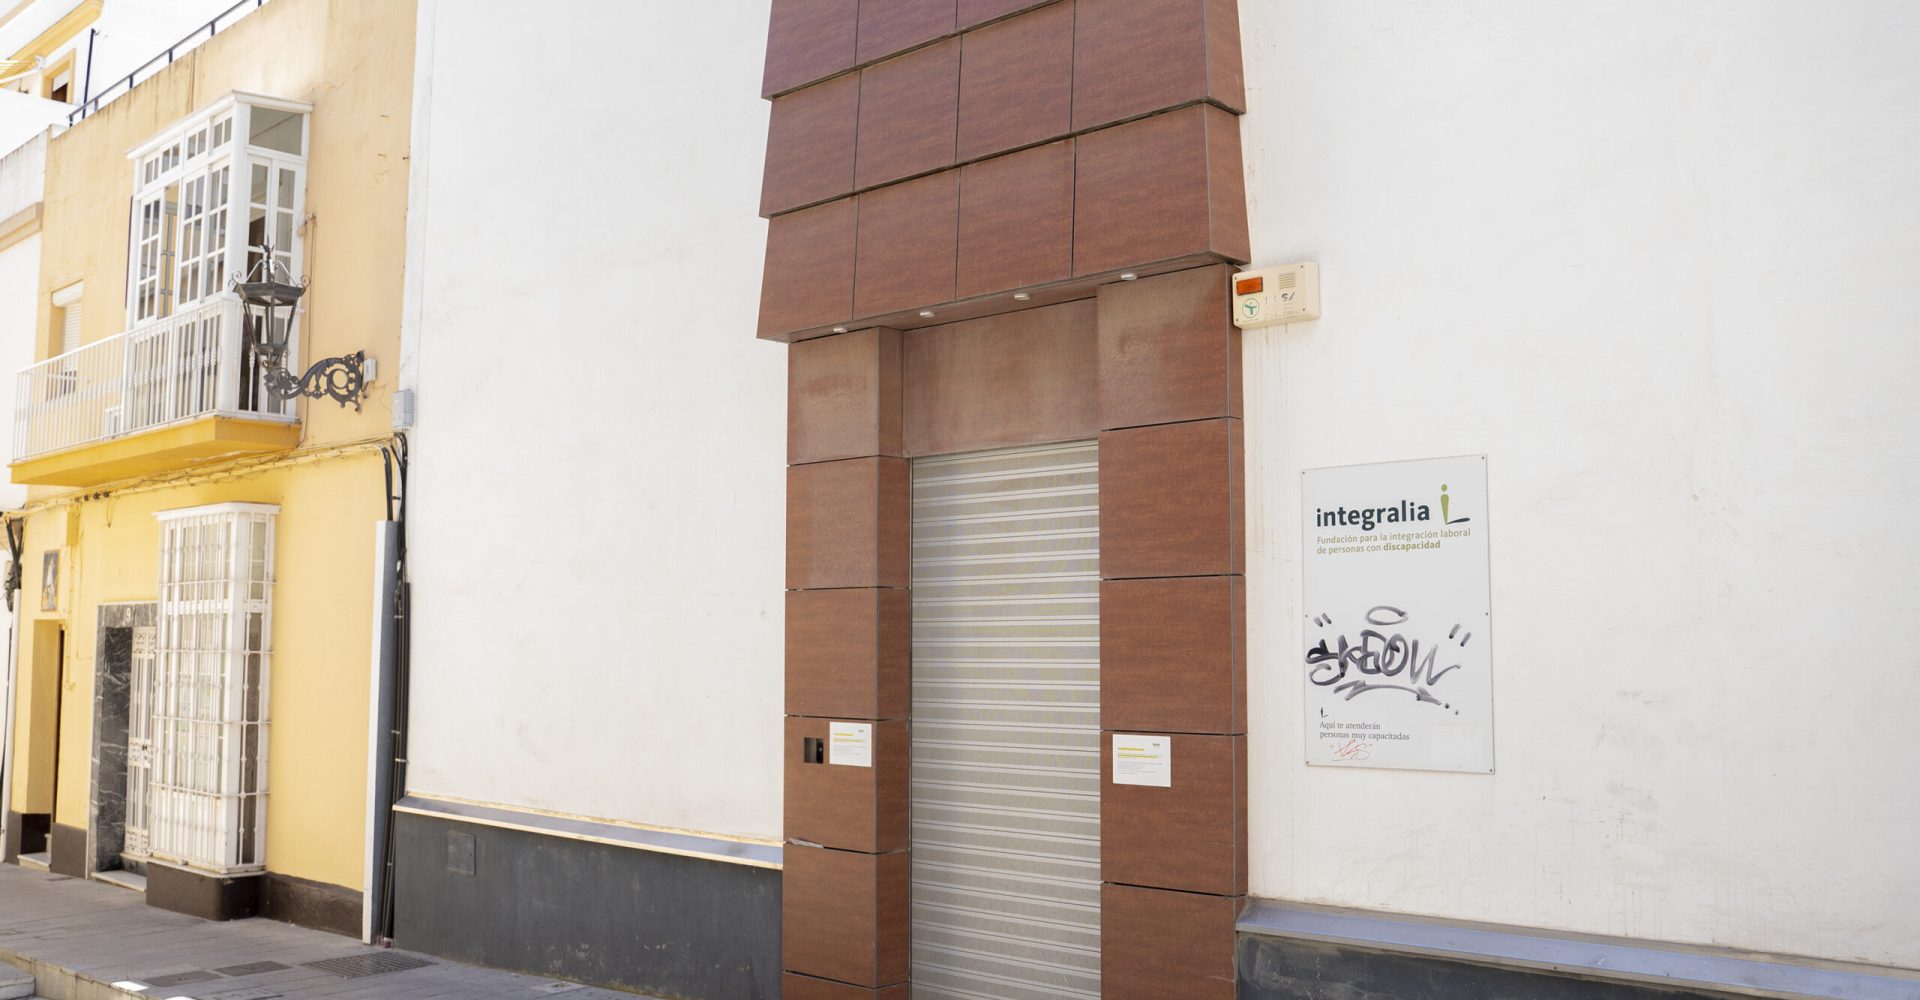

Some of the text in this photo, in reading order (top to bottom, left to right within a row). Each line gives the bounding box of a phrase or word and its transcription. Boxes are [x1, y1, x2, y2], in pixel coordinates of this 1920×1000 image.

[1316, 500, 1430, 531] integralia
[1317, 528, 1471, 546] Fundación para la integración laboral
[1317, 546, 1326, 554] de
[1329, 546, 1364, 555] personas
[1383, 540, 1441, 552] discapacidad
[1320, 721, 1335, 730] Aquí
[1346, 722, 1380, 730] atenderán
[1320, 731, 1349, 739] personas
[1369, 733, 1410, 741] capacitadas
